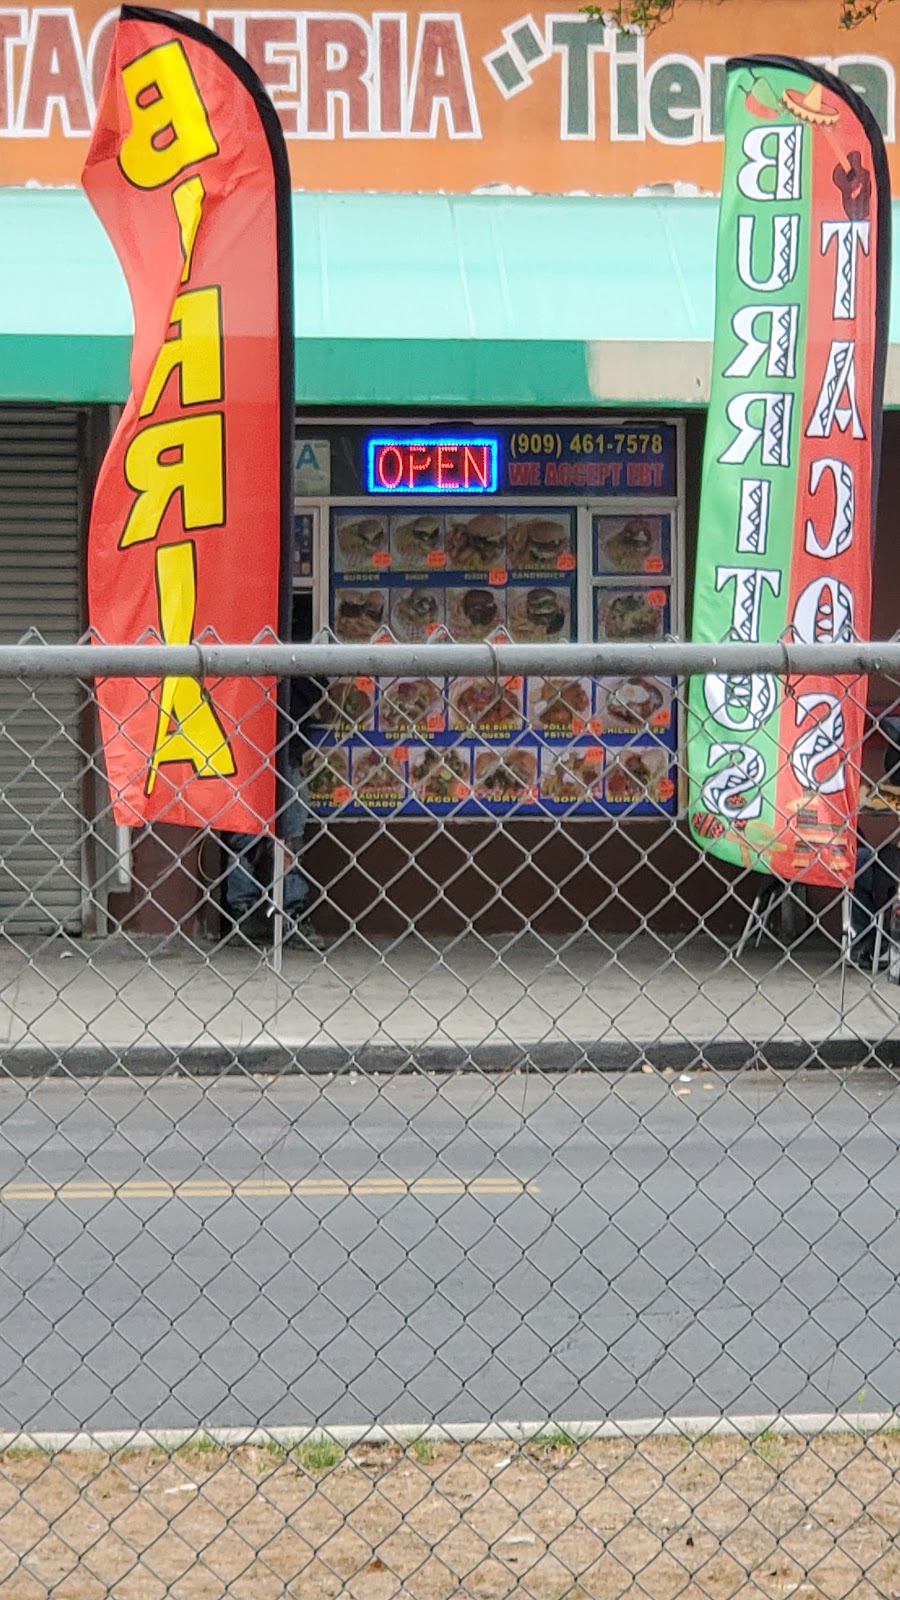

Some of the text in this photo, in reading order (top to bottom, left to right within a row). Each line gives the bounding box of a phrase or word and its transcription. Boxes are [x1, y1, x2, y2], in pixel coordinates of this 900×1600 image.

[0, 7, 483, 139] TAERIA
[296, 443, 321, 470] A
[510, 432, 562, 459] (909)
[378, 444, 489, 489] OPEN
[508, 462, 664, 487] WE ACCEPT EBT
[544, 731, 573, 739] FRITO
